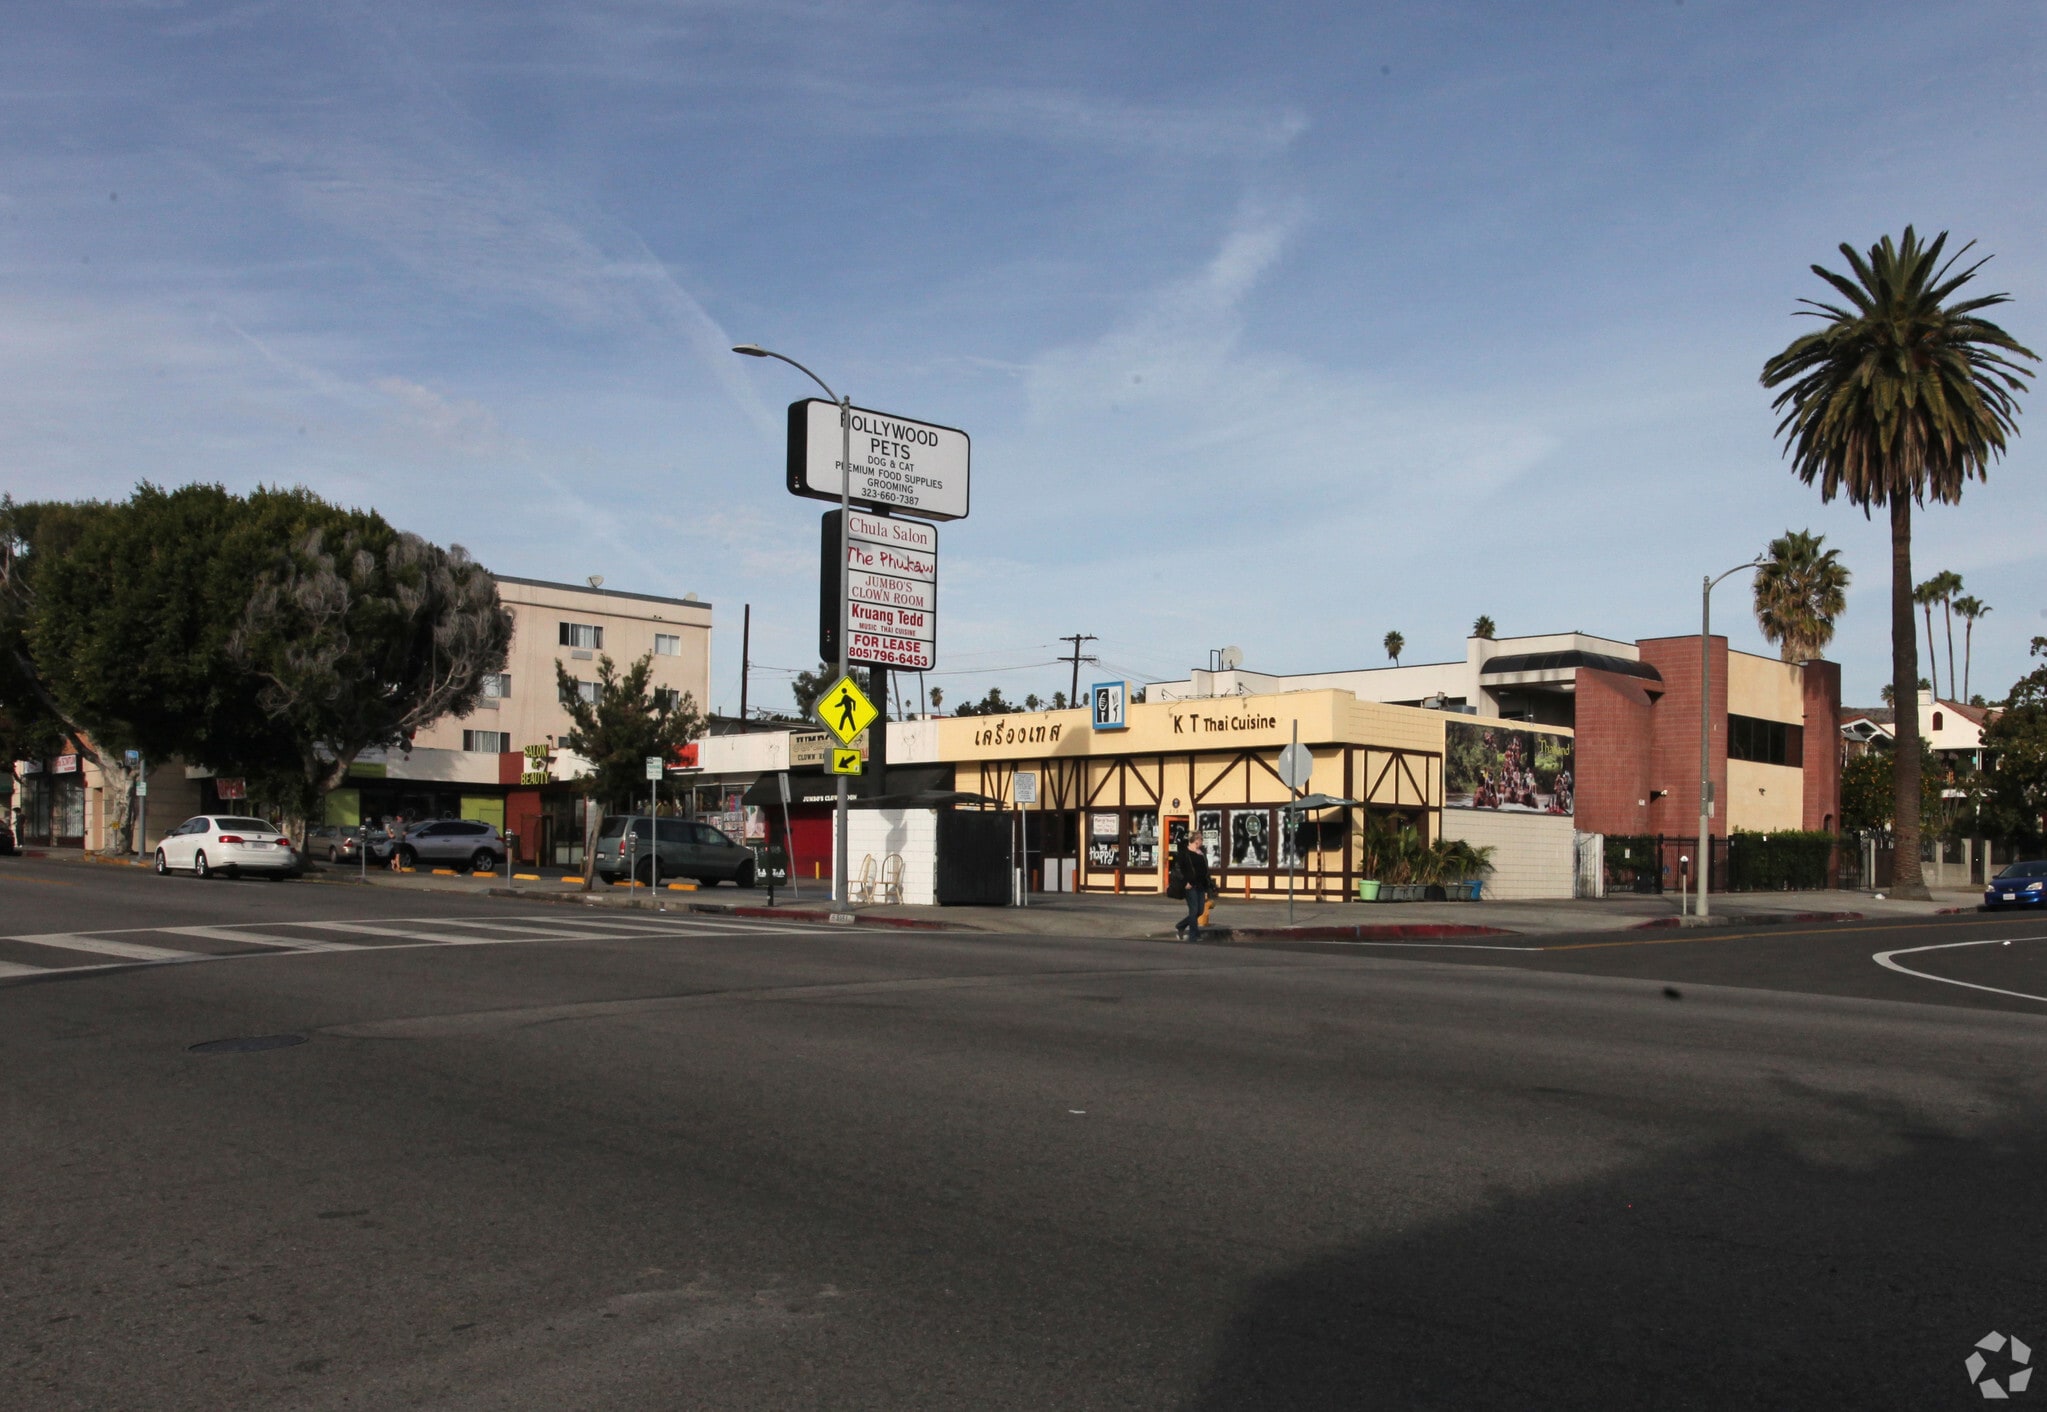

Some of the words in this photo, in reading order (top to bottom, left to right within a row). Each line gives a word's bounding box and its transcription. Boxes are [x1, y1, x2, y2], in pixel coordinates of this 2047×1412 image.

[841, 412, 938, 447] HOLLYWOOD
[871, 437, 911, 460] PETS
[868, 455, 886, 467] DOG
[889, 460, 896, 468] &
[899, 461, 915, 472] CAT
[835, 461, 875, 476] PEMIUM
[878, 469, 902, 482] FOOD
[905, 474, 943, 489] SUPPLIES
[867, 478, 914, 494] GROOMING
[861, 488, 920, 506] 323-660-7387
[849, 517, 888, 538] Chula
[893, 525, 928, 545] Salon
[847, 546, 874, 566] The
[865, 576, 913, 593] JUMBO'S
[851, 586, 890, 603] CLOWN
[894, 593, 924, 607] ROOM
[851, 603, 894, 626] Kruang
[898, 610, 924, 627] Tedd
[859, 622, 877, 631] MUSIC
[881, 625, 894, 634] THAI
[895, 628, 916, 637] CUISINE
[854, 634, 879, 648] FOR
[883, 638, 921, 653] LEASE
[849, 646, 928, 667] 805)796-6453
[1174, 714, 1184, 734] K
[1190, 713, 1199, 733] T
[1203, 715, 1228, 733] Thai
[1231, 713, 1277, 731] Cuisine
[525, 745, 548, 758] SALON
[521, 771, 550, 785] BEAUTY
[1089, 844, 1116, 865] Happy
